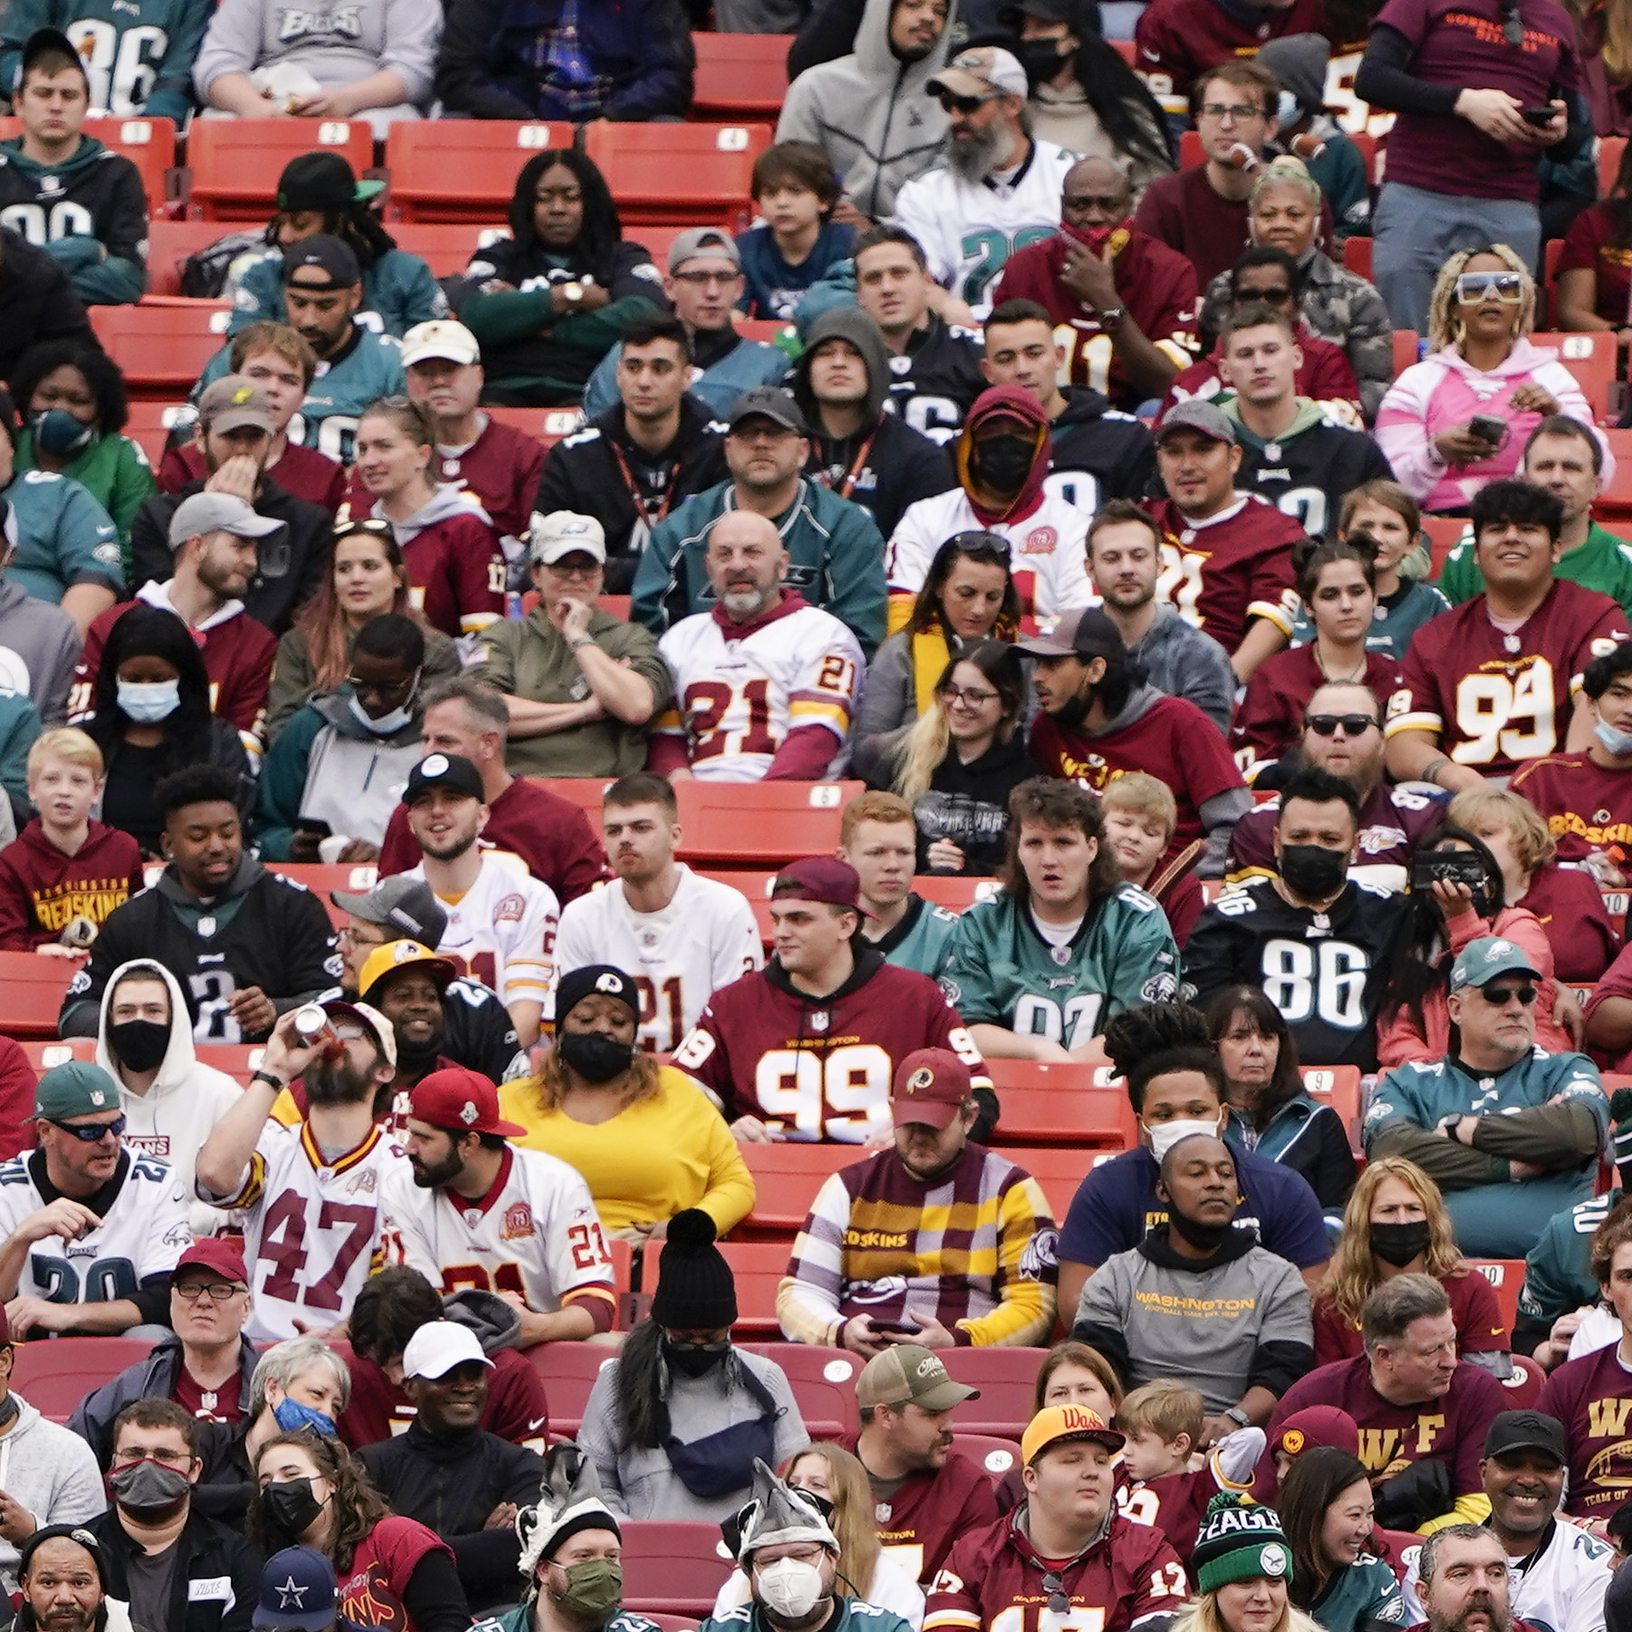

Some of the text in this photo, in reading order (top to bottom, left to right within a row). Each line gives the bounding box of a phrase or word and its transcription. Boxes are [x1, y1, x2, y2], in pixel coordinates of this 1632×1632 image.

[818, 655, 855, 694] 21
[687, 679, 774, 766] 21
[1453, 658, 1559, 764] 99
[1604, 894, 1624, 912] 10
[1264, 941, 1368, 1027] 86
[756, 1046, 893, 1142] 99
[258, 1189, 379, 1310] 47
[567, 1223, 612, 1267] 21
[1135, 1290, 1256, 1311] WASHINGTON
[1586, 1490, 1611, 1508] TEAM
